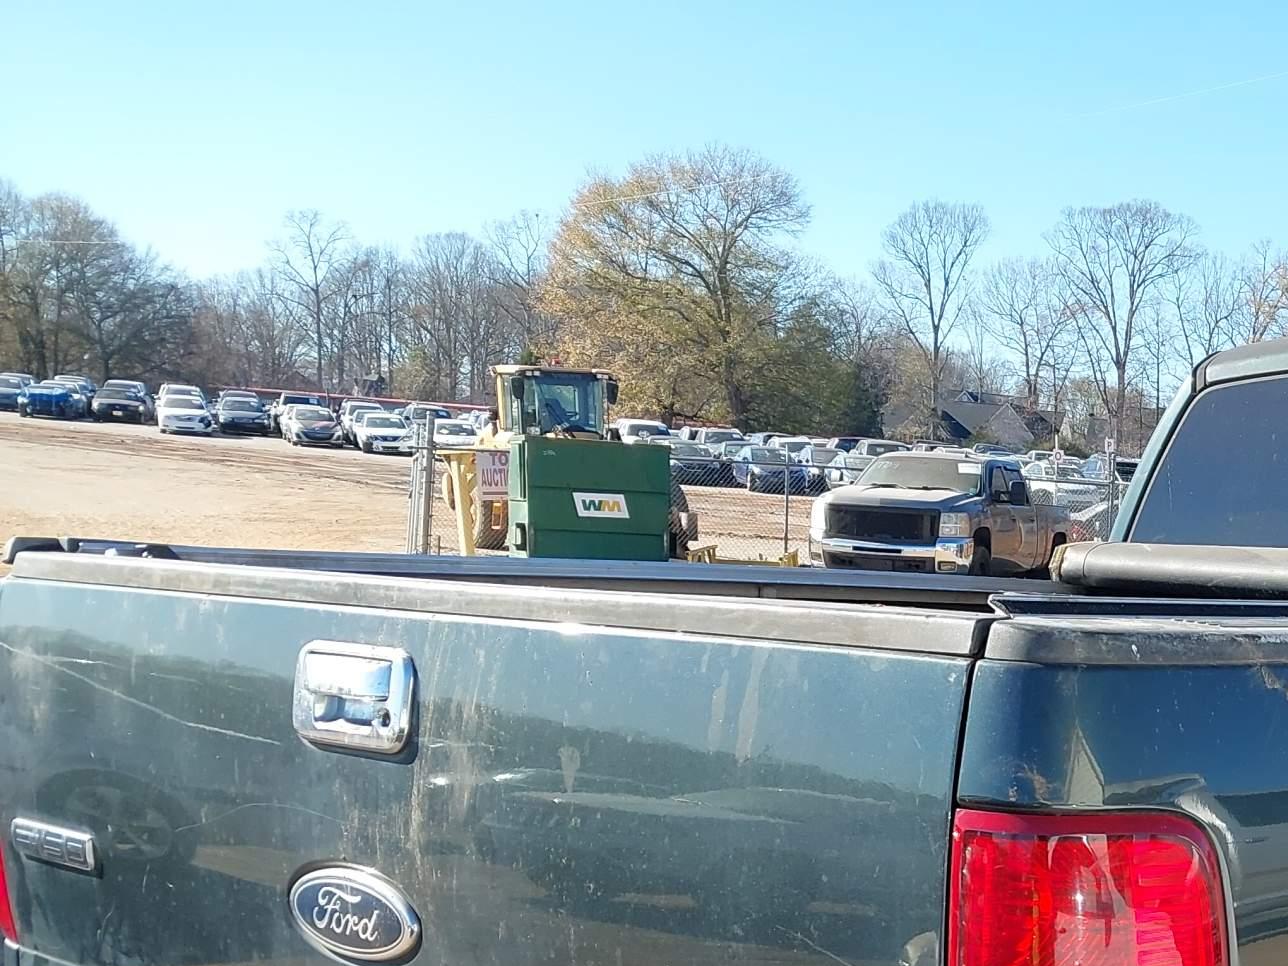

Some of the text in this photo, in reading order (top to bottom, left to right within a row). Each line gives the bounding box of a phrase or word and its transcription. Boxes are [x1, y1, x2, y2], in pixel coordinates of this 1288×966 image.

[488, 452, 509, 467] TO
[481, 467, 509, 487] AUCTI
[580, 498, 622, 513] WM
[312, 885, 381, 943] Ford
